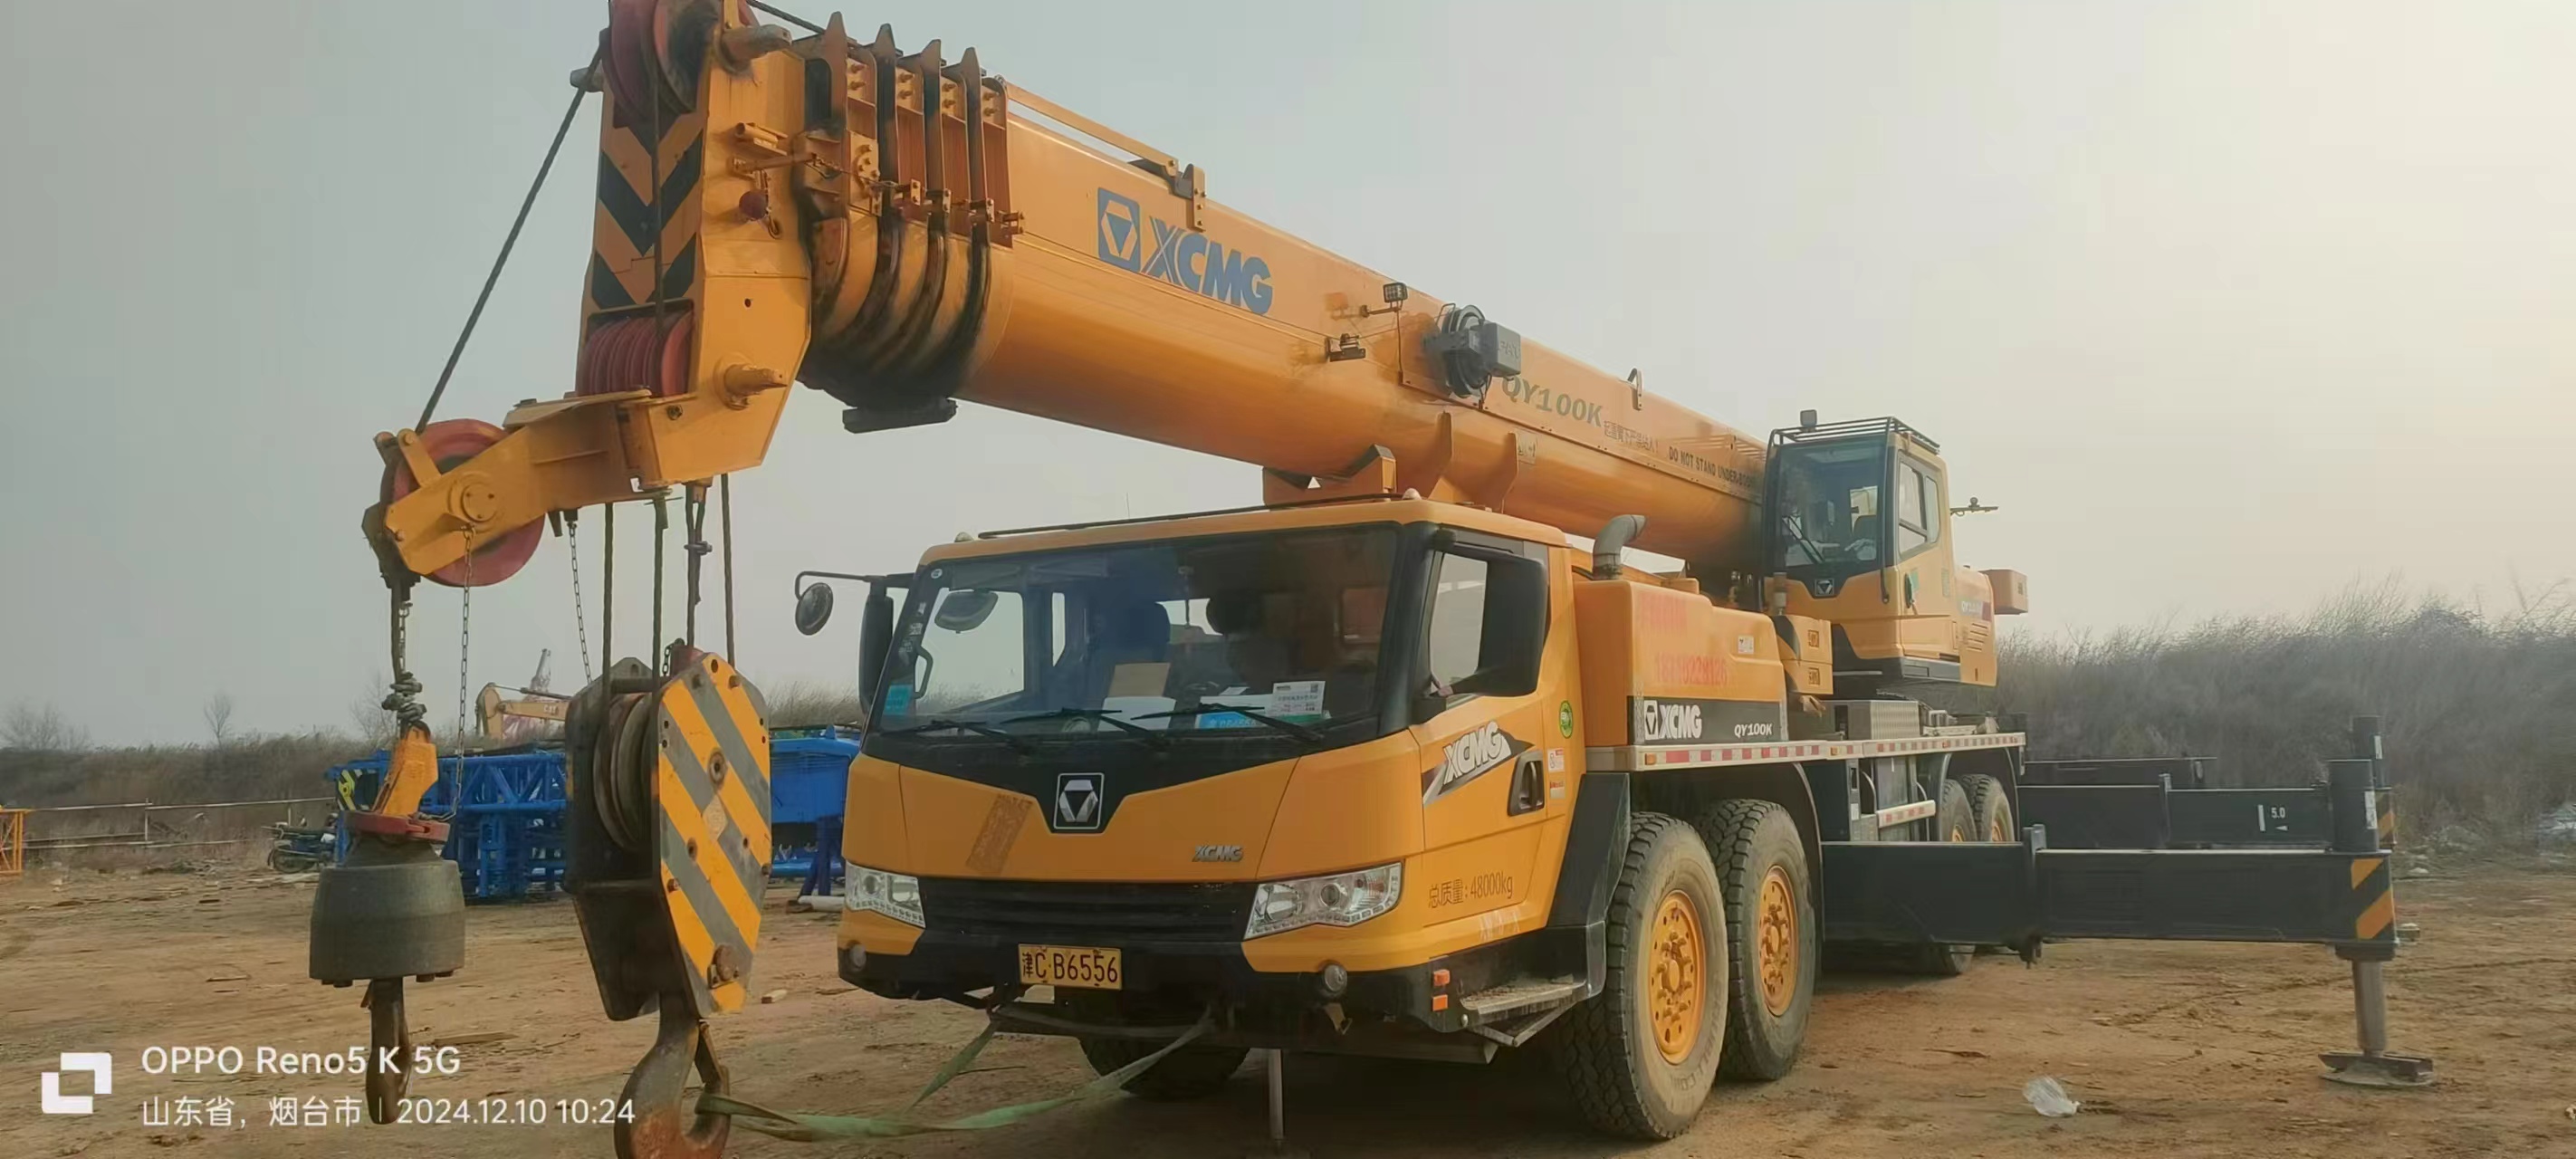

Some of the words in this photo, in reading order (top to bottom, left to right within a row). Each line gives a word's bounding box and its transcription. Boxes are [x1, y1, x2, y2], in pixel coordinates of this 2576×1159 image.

[1144, 216, 1273, 315] XCMG
[1501, 376, 1604, 428] QY100K
[1669, 445, 1679, 462] DO
[1681, 451, 1693, 468] NOT
[1695, 456, 1716, 476] STAND
[1659, 704, 1702, 740] XCMG
[1733, 722, 1774, 738] QY100K
[1443, 721, 1503, 785] XCMG
[2271, 807, 2286, 819] 5.0
[1192, 845, 1243, 862] XCMG
